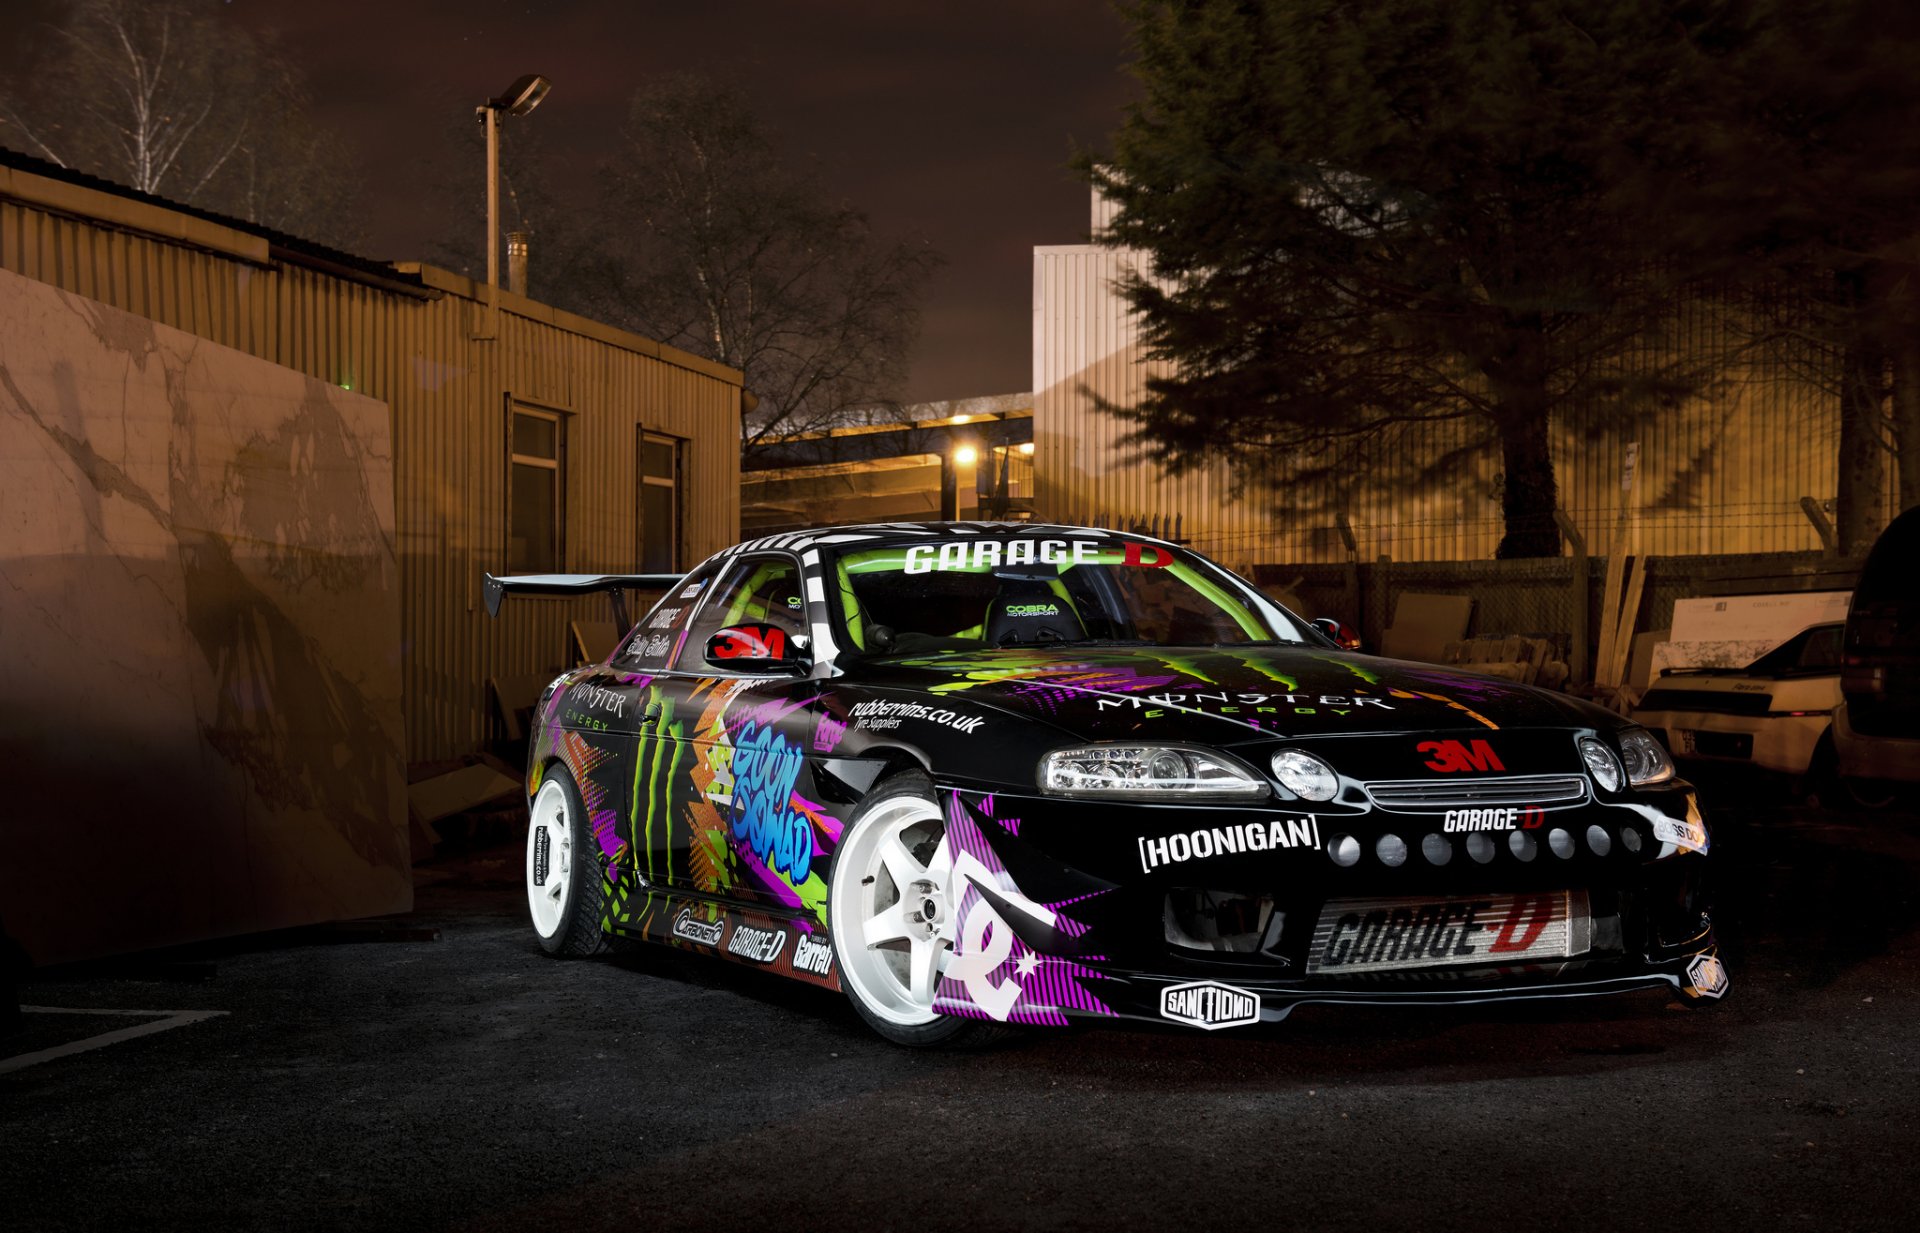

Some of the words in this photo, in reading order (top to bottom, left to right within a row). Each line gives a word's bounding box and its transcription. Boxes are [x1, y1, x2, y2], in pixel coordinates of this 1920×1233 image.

[1006, 604, 1058, 612] COBRA
[714, 627, 785, 660] 3M
[569, 682, 627, 718] MONSTER
[1097, 691, 1396, 711] MONSTER
[1145, 706, 1350, 718] ENERGY
[566, 708, 608, 732] ENERGY
[848, 699, 985, 734] rubberrims.co.uk
[1416, 739, 1506, 773] 3M
[1443, 805, 1545, 833] GARAGE-D
